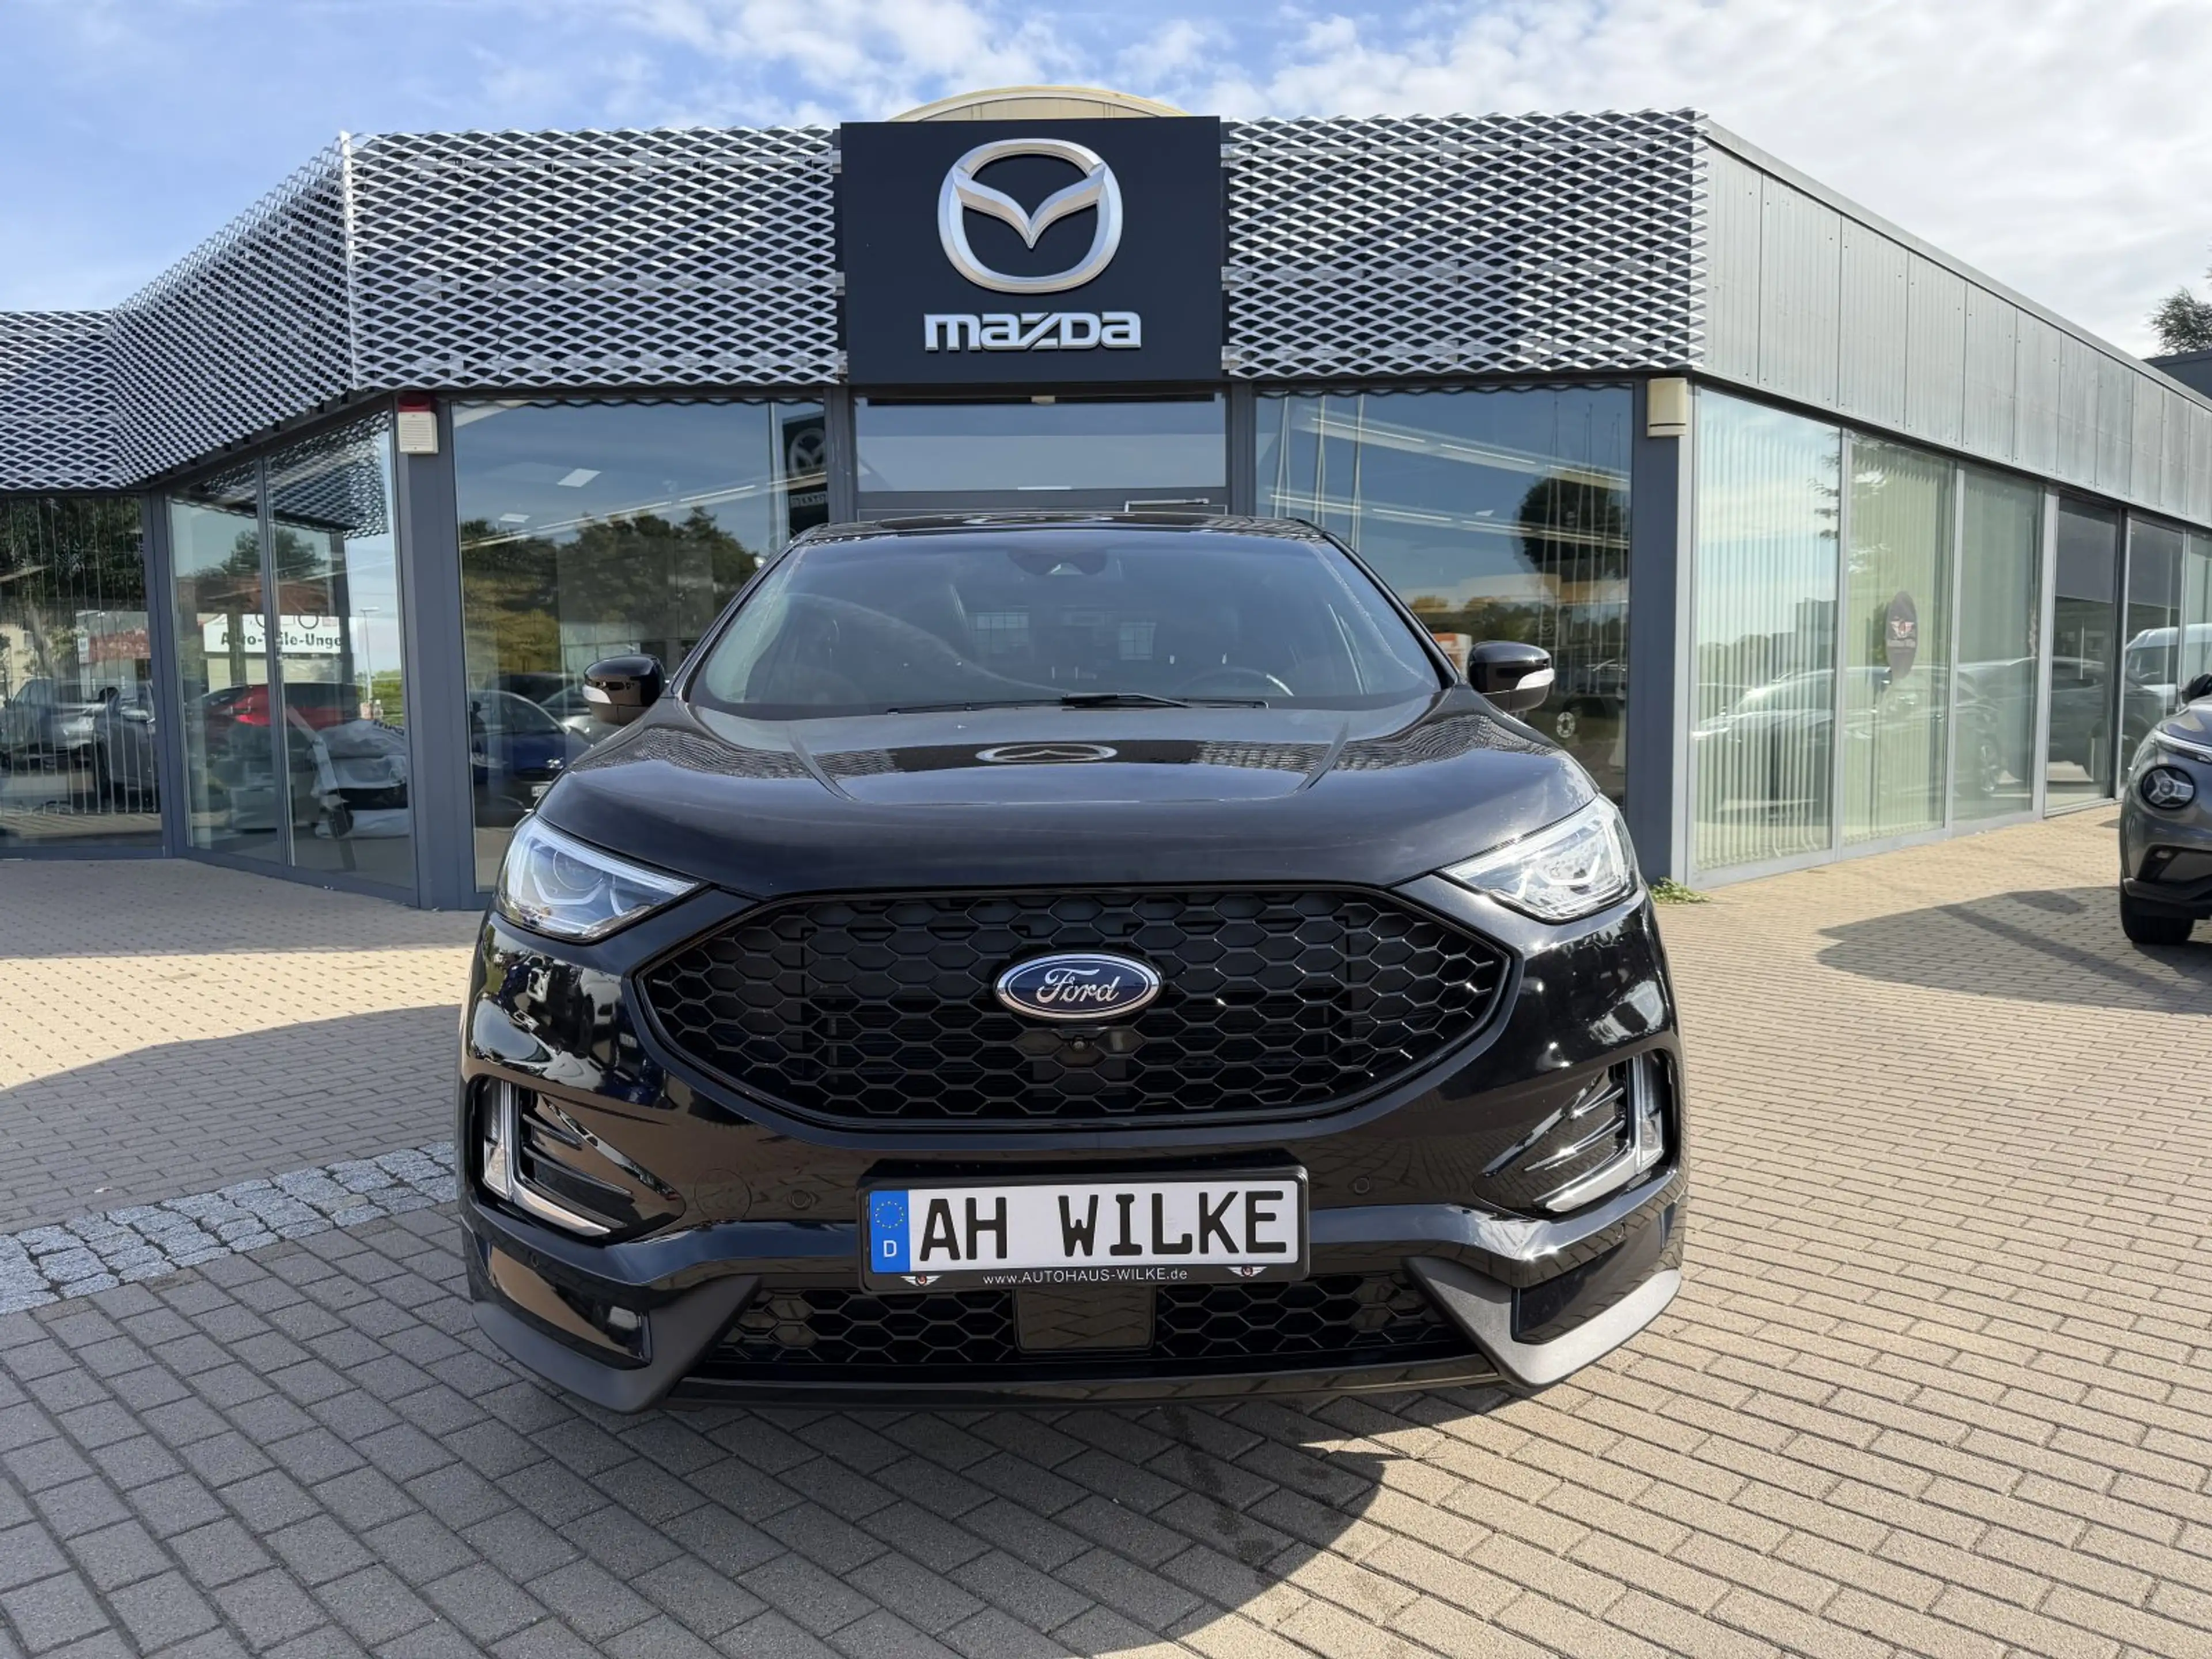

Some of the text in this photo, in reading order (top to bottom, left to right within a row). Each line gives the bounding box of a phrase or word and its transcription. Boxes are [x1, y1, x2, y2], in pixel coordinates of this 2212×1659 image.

[1036, 968, 1120, 1003] Ford
[920, 1191, 1286, 1261] AH WILKE
[883, 1240, 897, 1257] D
[983, 1268, 1188, 1284] www.AUTOHAUS-WILKE.de
